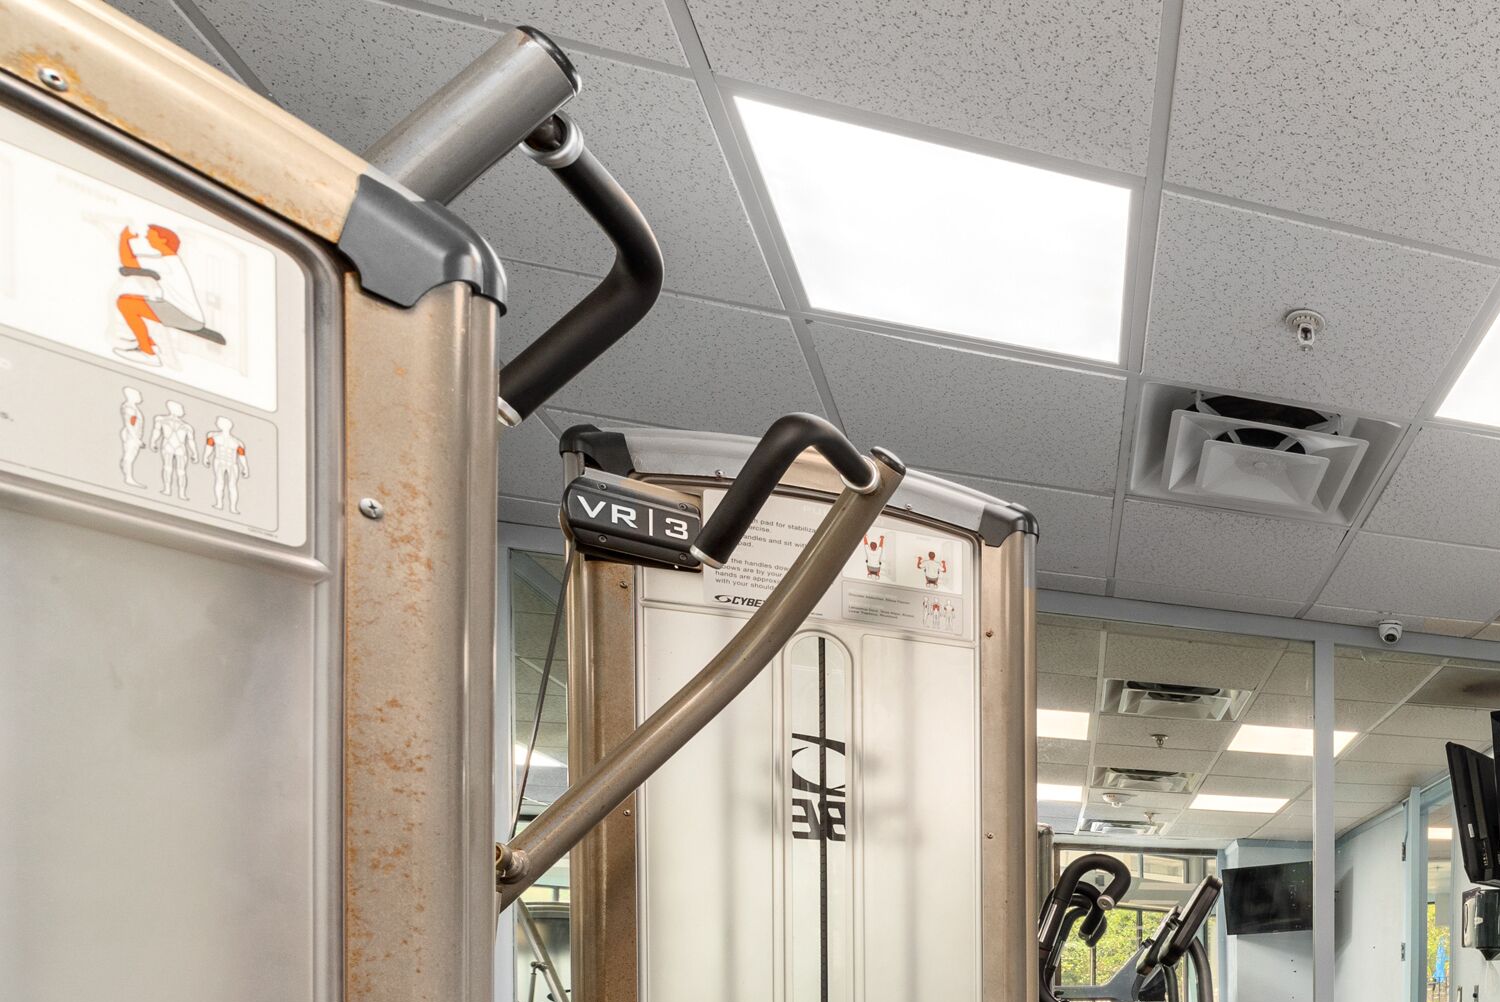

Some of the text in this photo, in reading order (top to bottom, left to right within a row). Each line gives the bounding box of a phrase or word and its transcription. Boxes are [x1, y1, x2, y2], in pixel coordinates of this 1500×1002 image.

[760, 520, 774, 528] pad
[744, 560, 772, 570] handles
[715, 570, 738, 578] hands
[756, 568, 766, 576] by
[767, 570, 783, 578] your
